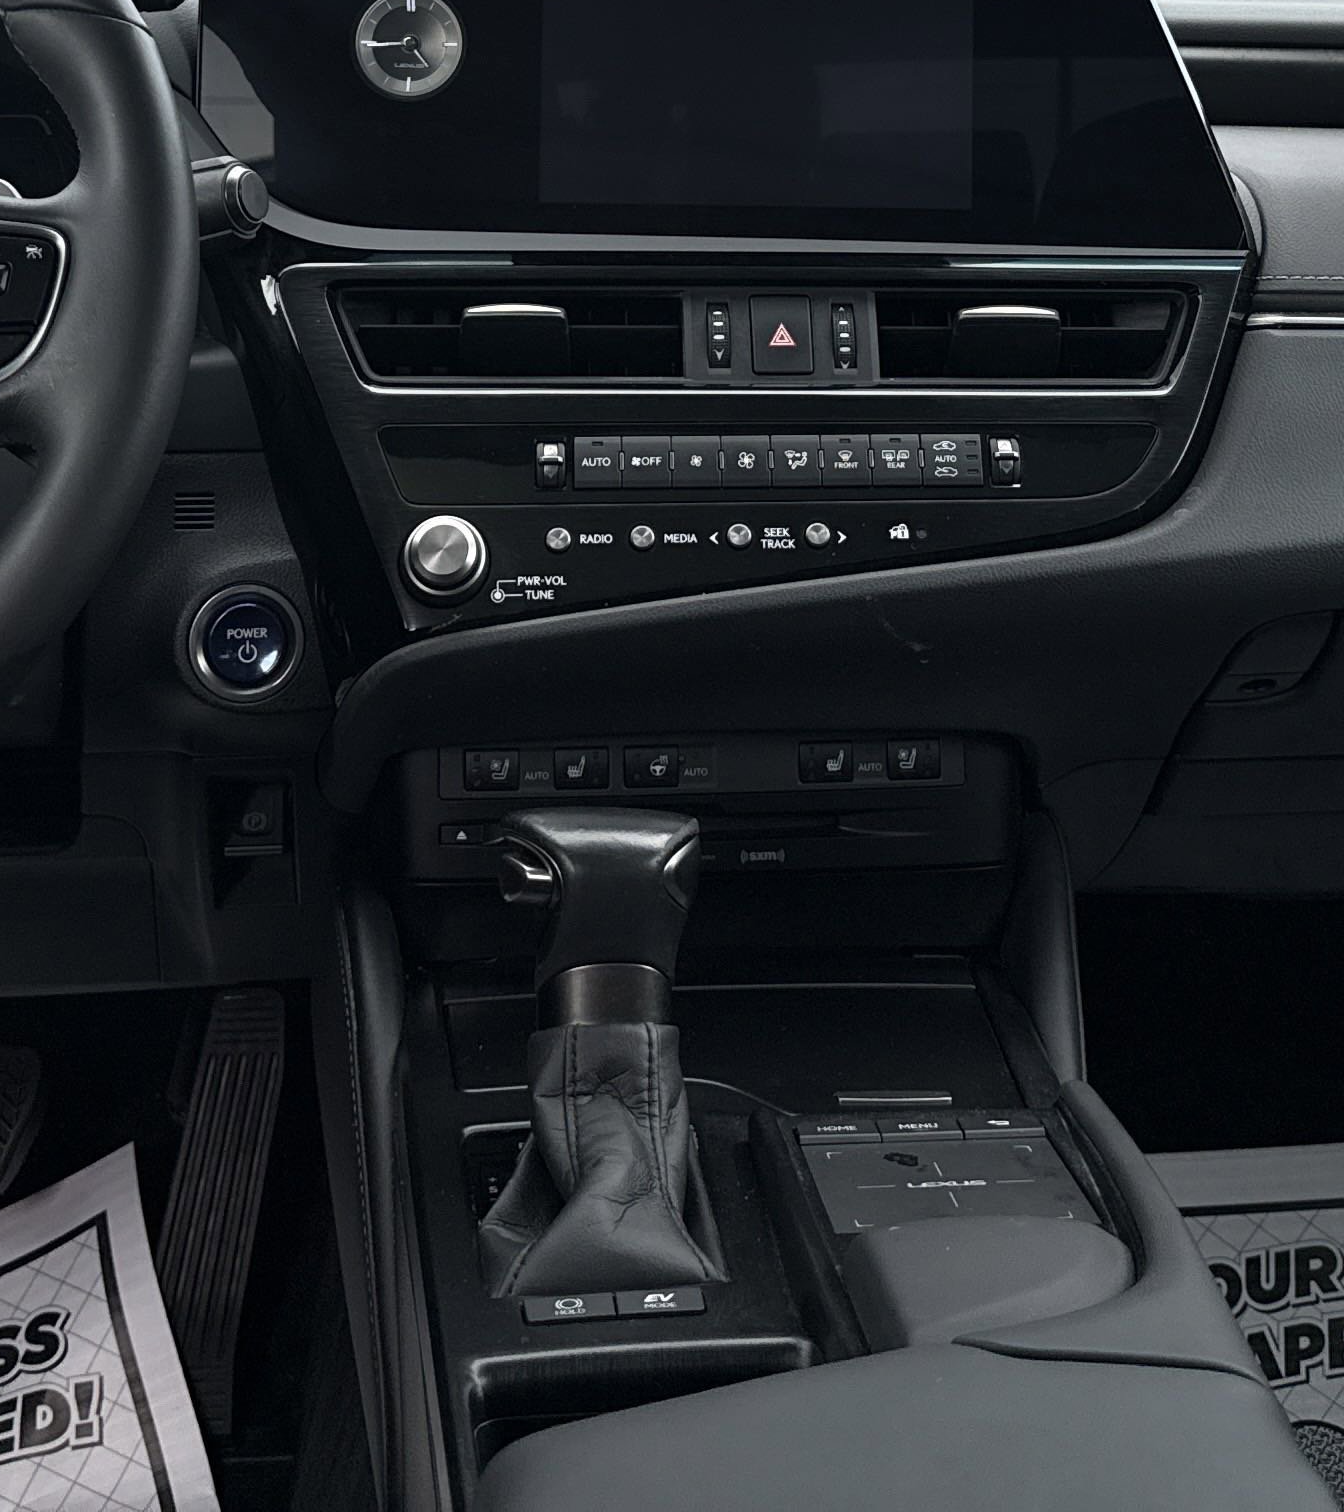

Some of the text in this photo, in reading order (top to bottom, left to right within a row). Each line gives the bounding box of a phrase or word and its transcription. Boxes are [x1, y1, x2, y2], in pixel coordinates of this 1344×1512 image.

[581, 456, 612, 467] AUTO
[641, 456, 663, 467] OFF
[934, 454, 957, 464] AUTO
[833, 461, 859, 470] FRONT
[886, 461, 906, 470] REAR
[763, 527, 791, 538] SEEK
[579, 533, 614, 545] RADIO
[663, 533, 699, 545] MEDIA
[759, 538, 797, 550] TRACK
[524, 589, 556, 600] TUNE
[226, 627, 268, 640] POWER
[683, 767, 709, 778] AUTO
[857, 762, 884, 773] AUTO
[523, 770, 550, 781] AUTO
[897, 1121, 940, 1131] MENU
[1208, 1245, 1342, 1312] OUR
